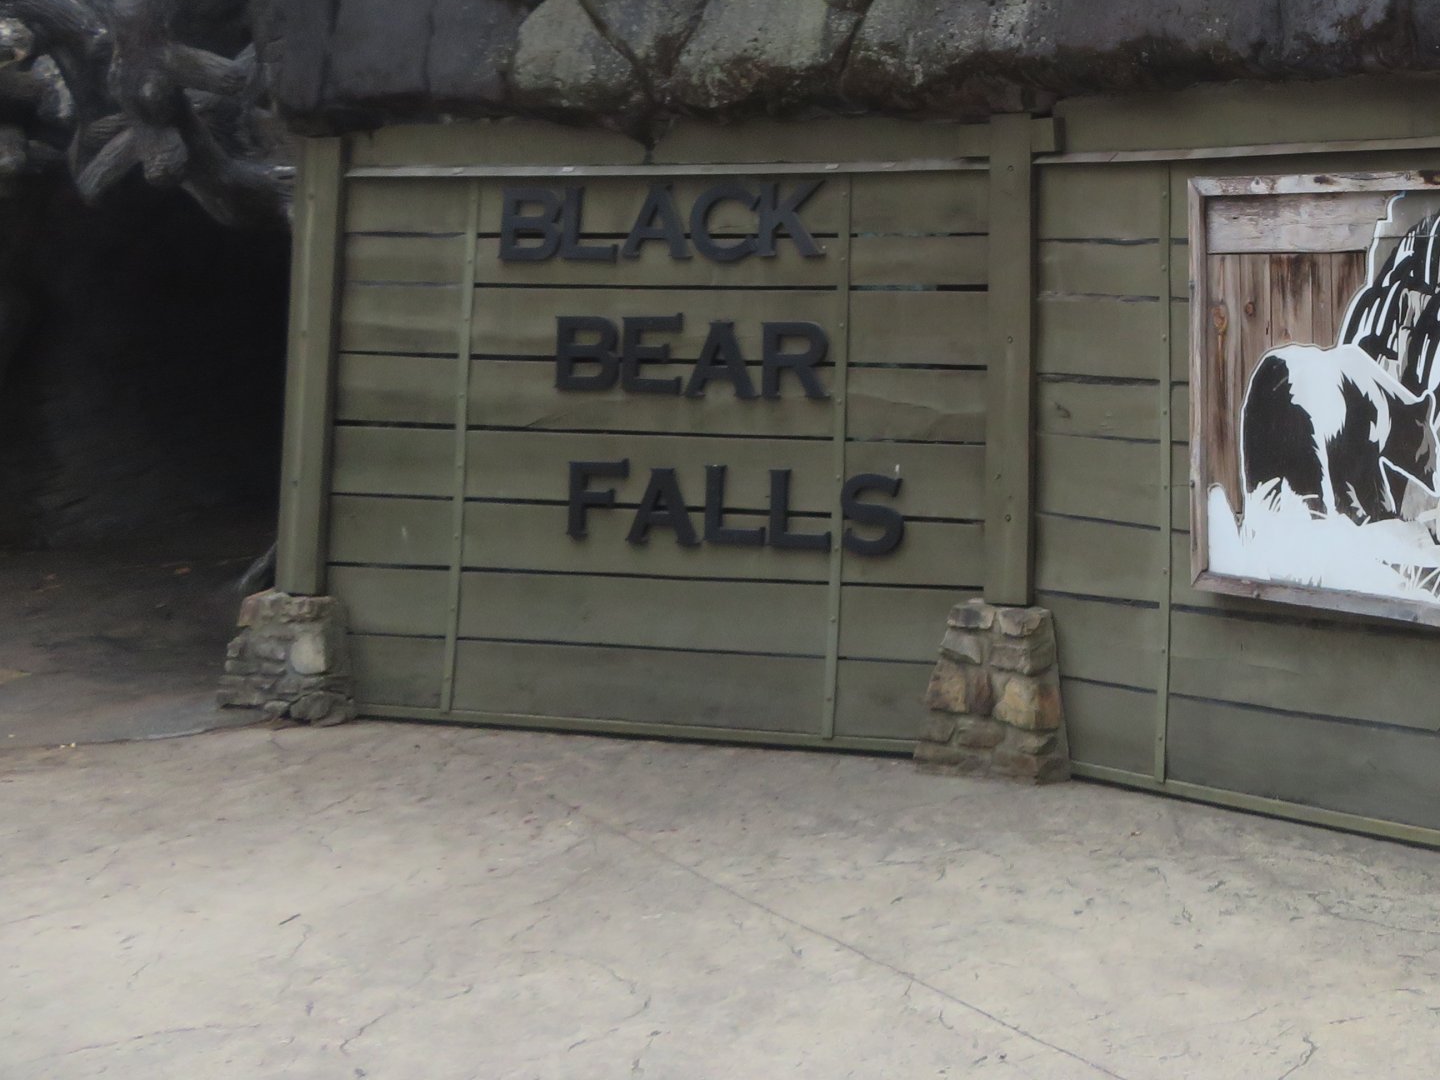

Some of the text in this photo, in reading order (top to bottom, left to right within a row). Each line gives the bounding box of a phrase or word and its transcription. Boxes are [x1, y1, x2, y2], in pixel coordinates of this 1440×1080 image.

[499, 179, 826, 263] BLACK
[554, 313, 832, 400] BEAR
[566, 458, 905, 557] FALLS
